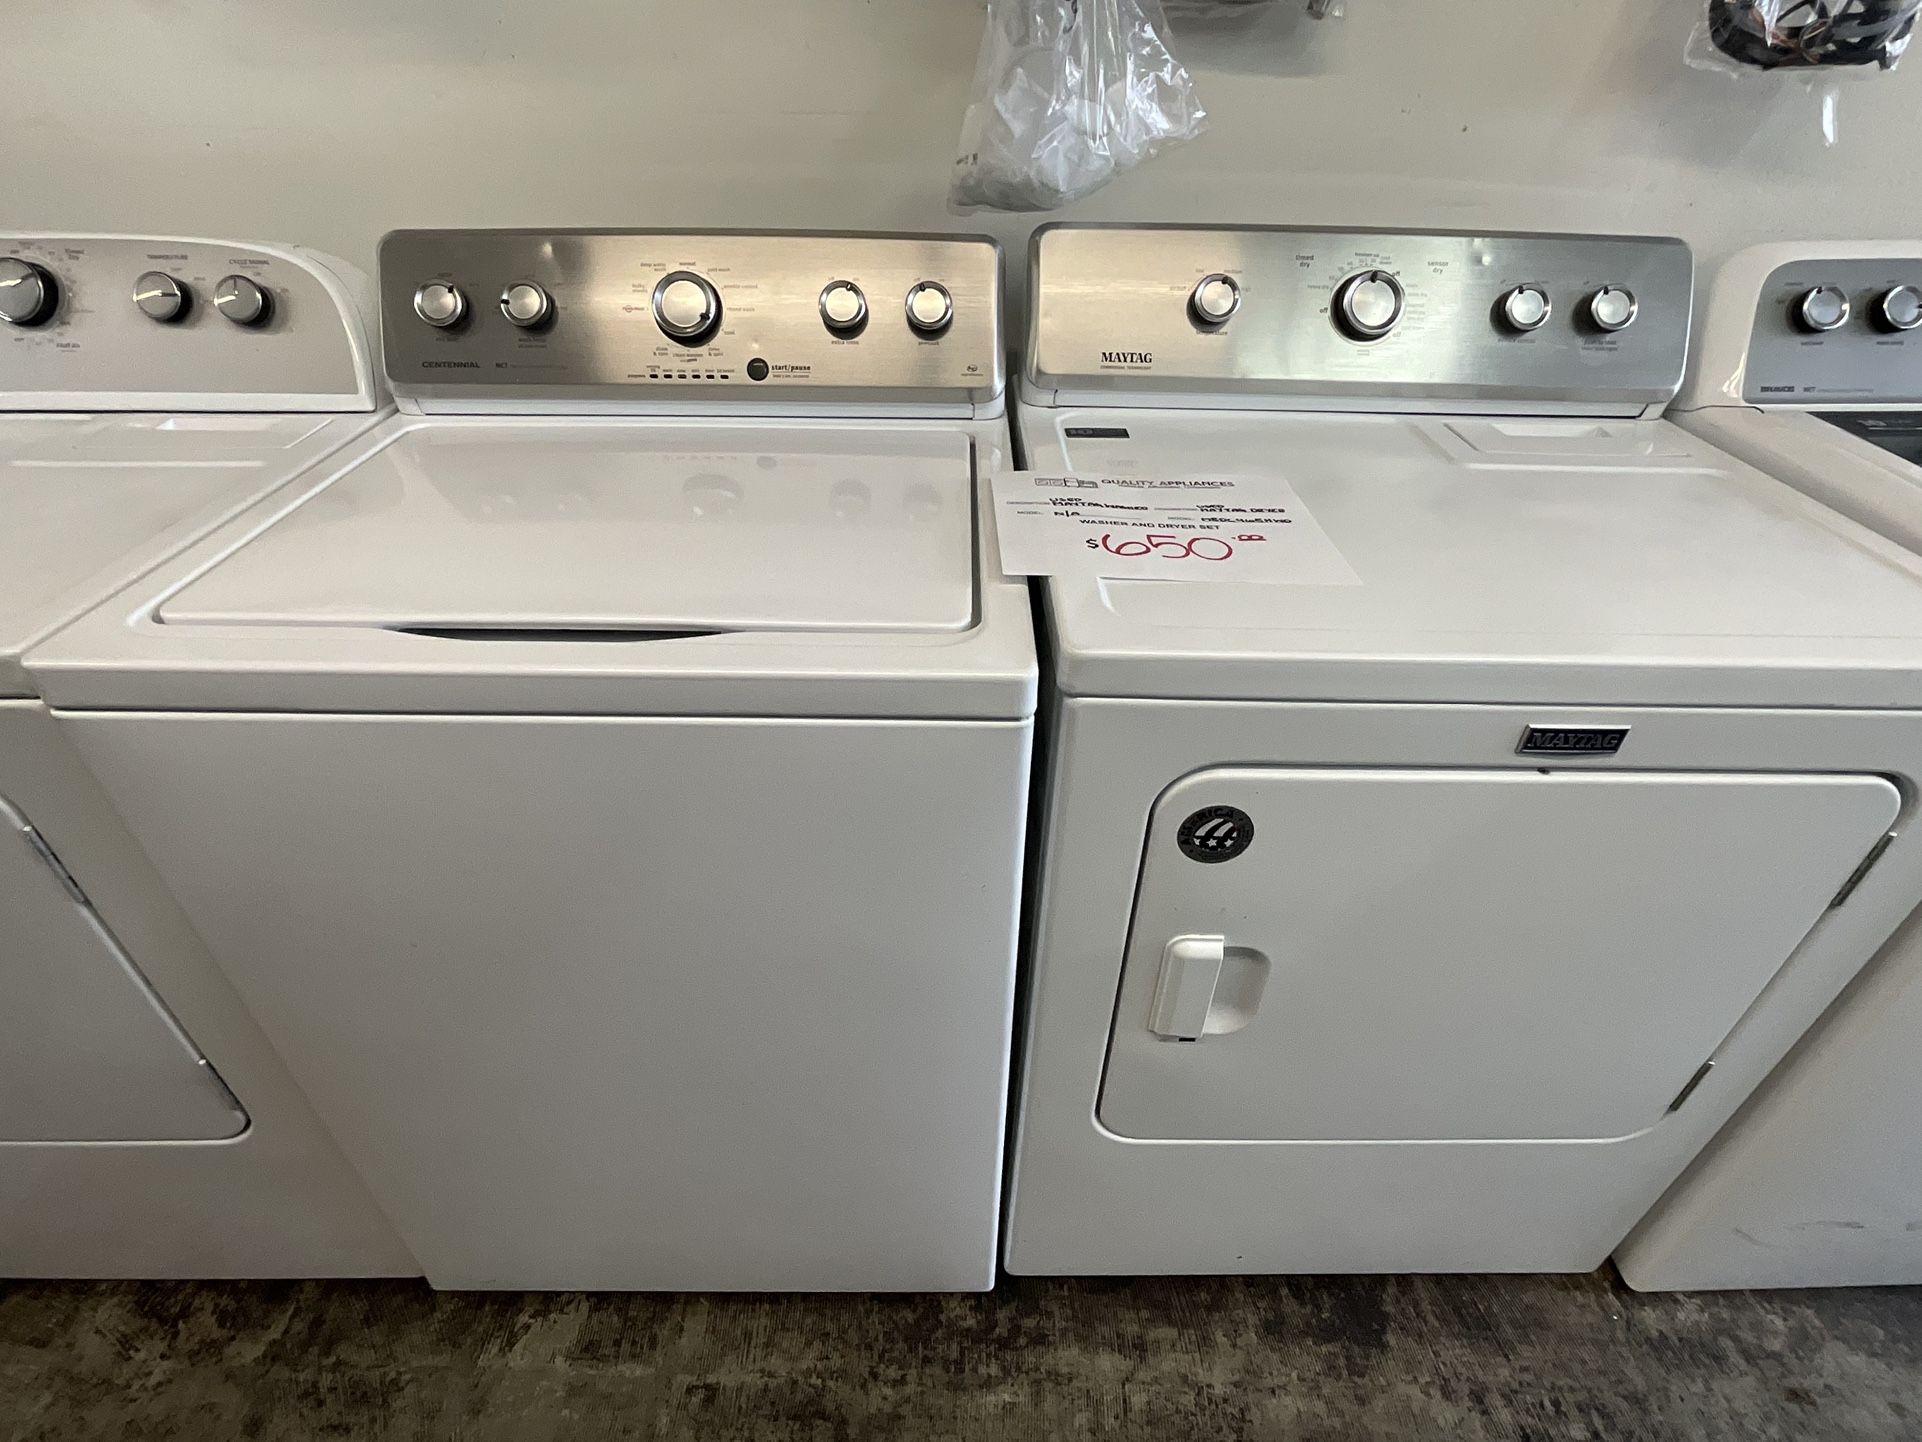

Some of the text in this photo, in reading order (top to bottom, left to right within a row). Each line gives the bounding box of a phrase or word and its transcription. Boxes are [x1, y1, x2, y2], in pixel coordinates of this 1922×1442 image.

[1100, 352, 1153, 363] MAYTAG
[771, 364, 811, 373] start/pause
[1101, 478, 1153, 486] QUALITY
[1054, 510, 1080, 518] N/A
[1079, 519, 1128, 527] WASHER
[1526, 732, 1620, 748] MAYTAG
